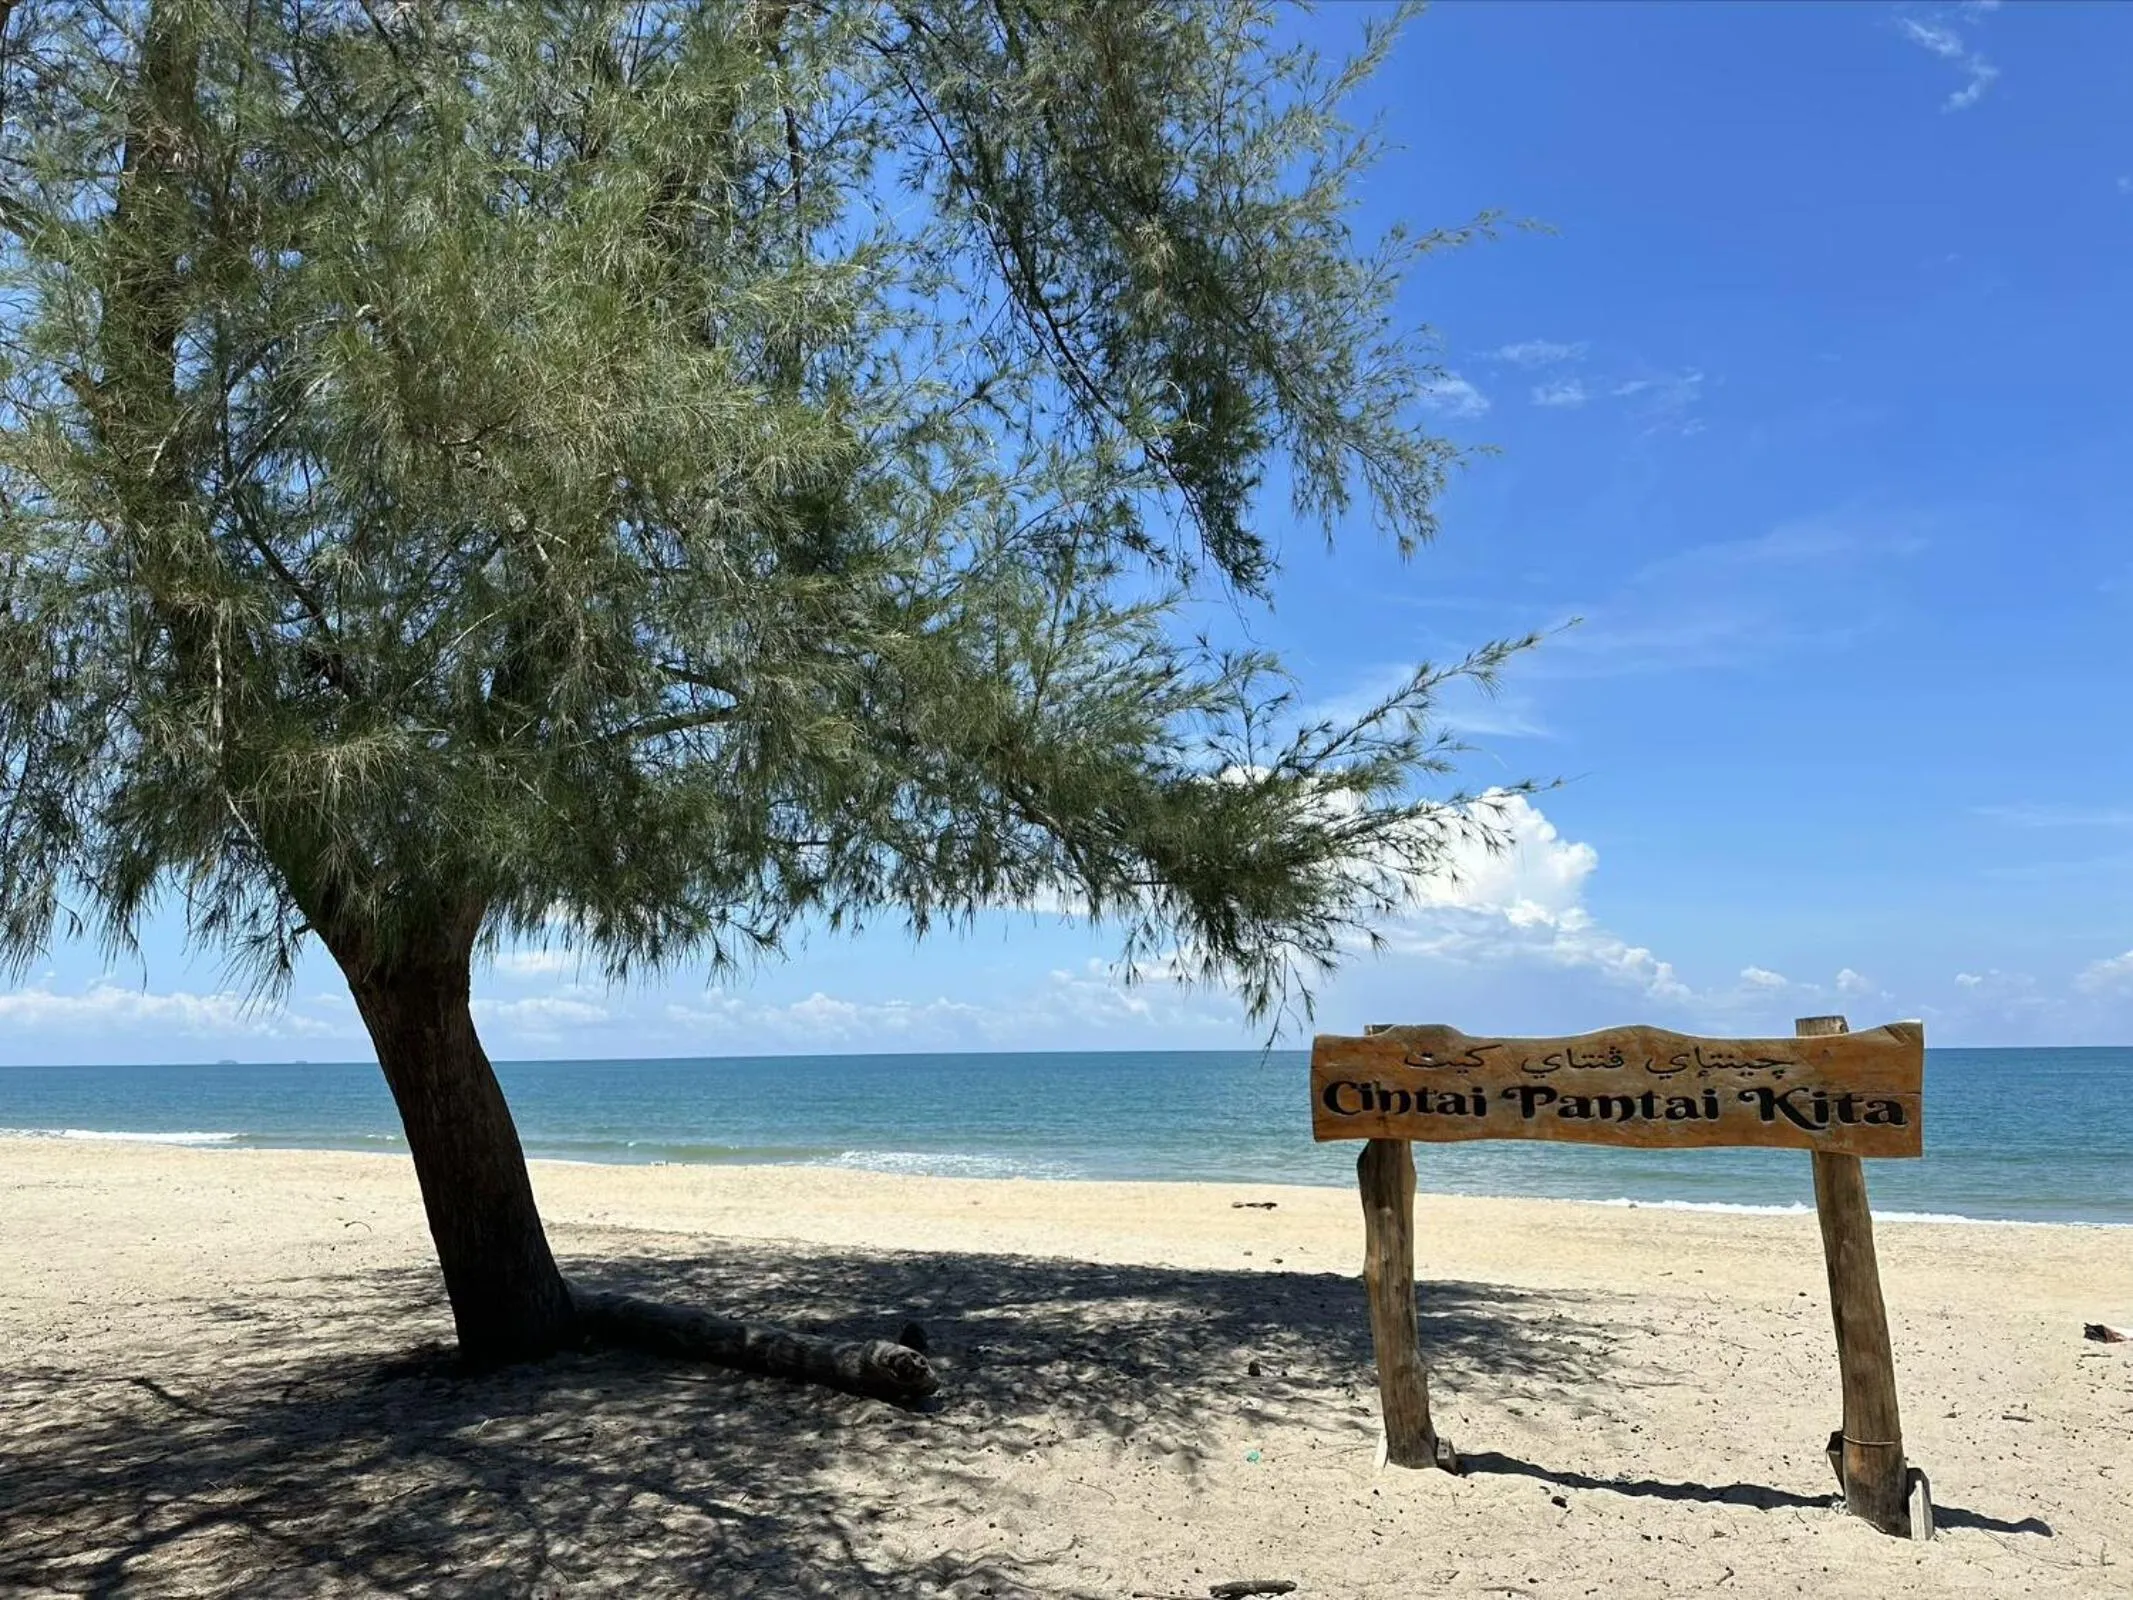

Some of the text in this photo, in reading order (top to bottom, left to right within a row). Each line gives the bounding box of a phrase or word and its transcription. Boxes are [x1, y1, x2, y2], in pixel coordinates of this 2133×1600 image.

[1322, 1080, 1909, 1131] Cintai Pantai Kita
